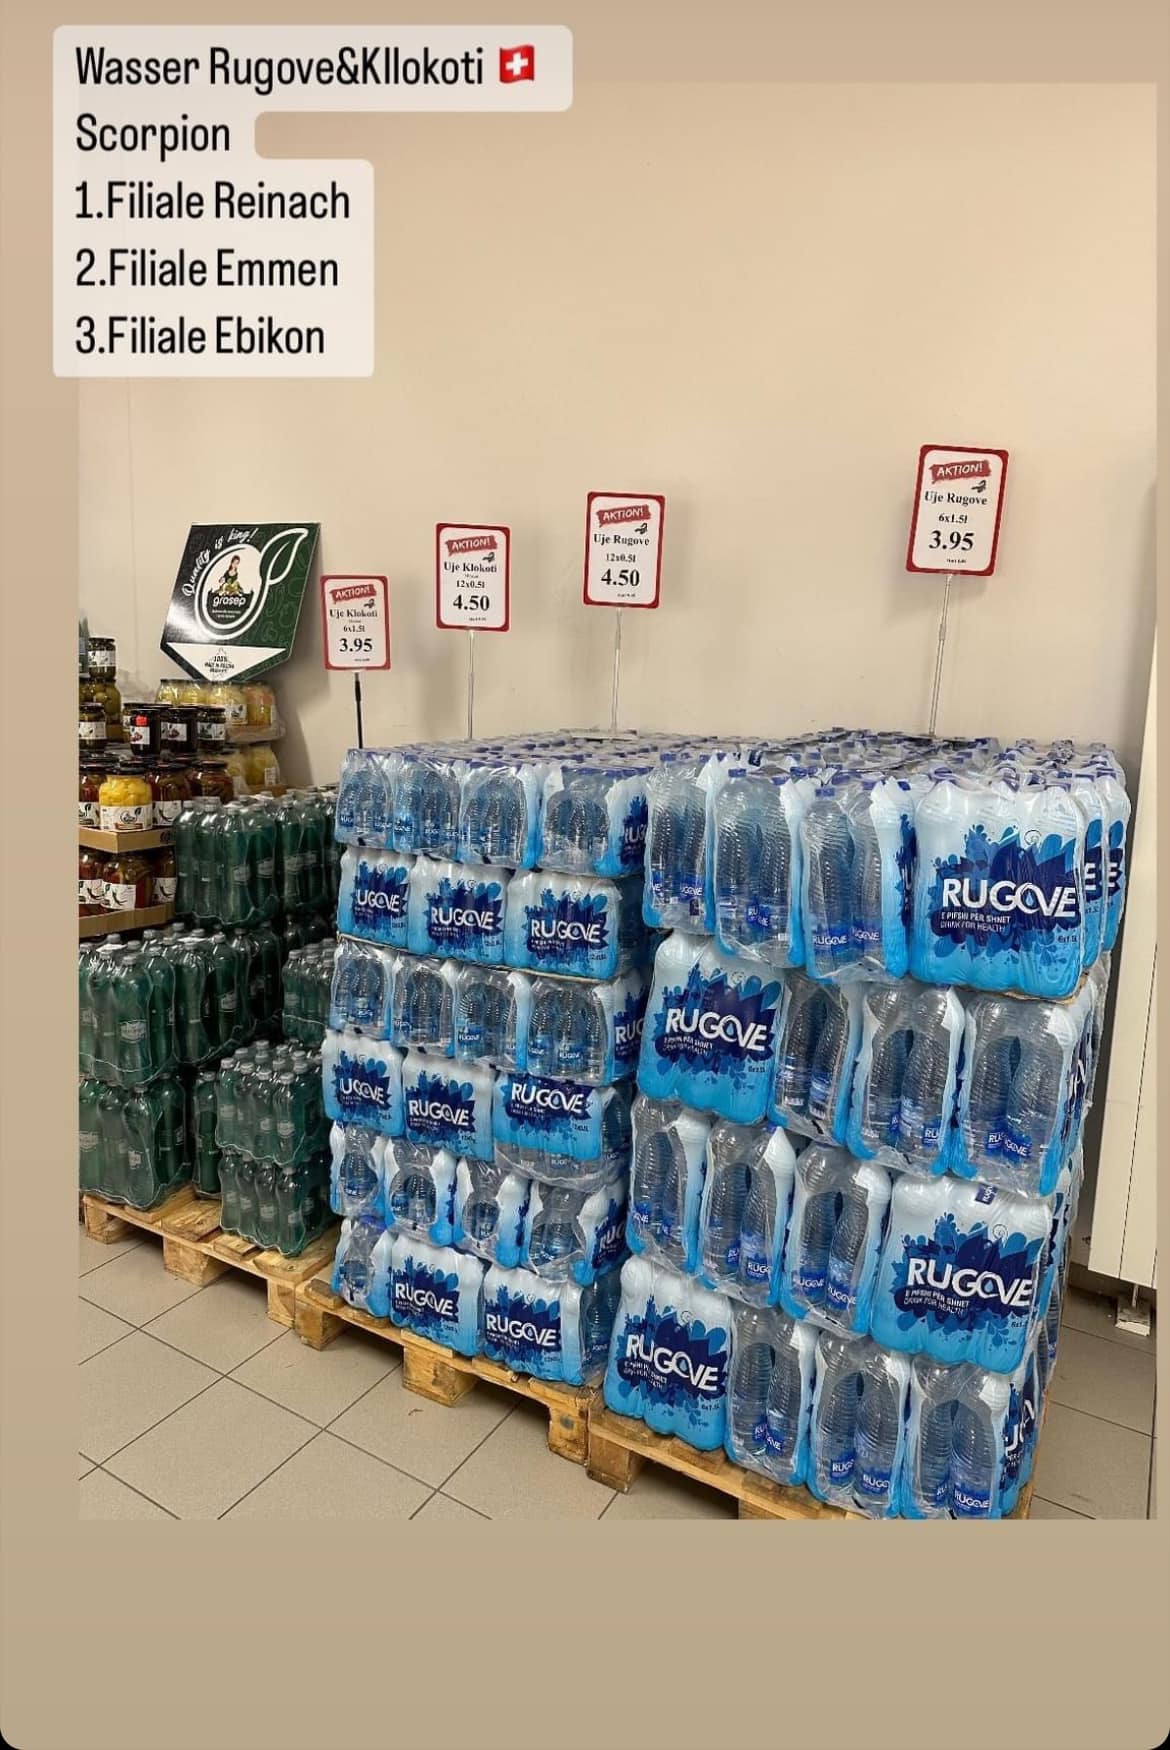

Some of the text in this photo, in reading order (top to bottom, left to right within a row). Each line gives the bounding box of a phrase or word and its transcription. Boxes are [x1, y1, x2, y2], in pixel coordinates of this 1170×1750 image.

[937, 465, 982, 476] AKTION!
[925, 491, 987, 506] Uje Rugove
[603, 509, 643, 520] AKTION!
[452, 538, 490, 549] AKTION!
[594, 534, 650, 546] Uje Rugove
[929, 530, 974, 550] 3.95
[444, 561, 497, 573] Uje Klokoti
[601, 569, 640, 586] 4.50
[336, 587, 370, 598] AKTION!
[453, 594, 490, 611] 4.50
[329, 609, 377, 619] Uje Klokoti
[339, 638, 373, 652] 3.95
[942, 878, 1076, 918] RUGOVE
[431, 906, 494, 930] RUGOVE
[531, 919, 601, 943] RUGOVE
[666, 1008, 767, 1051] RUGOVE
[511, 1083, 585, 1115] RUGOVE
[409, 1100, 469, 1128] RUGOVE
[907, 1258, 1033, 1307] RUGOVE
[395, 1283, 454, 1317] RUGOVE
[486, 1313, 559, 1347] RUGOVE
[626, 1334, 719, 1391] RUGOVE
